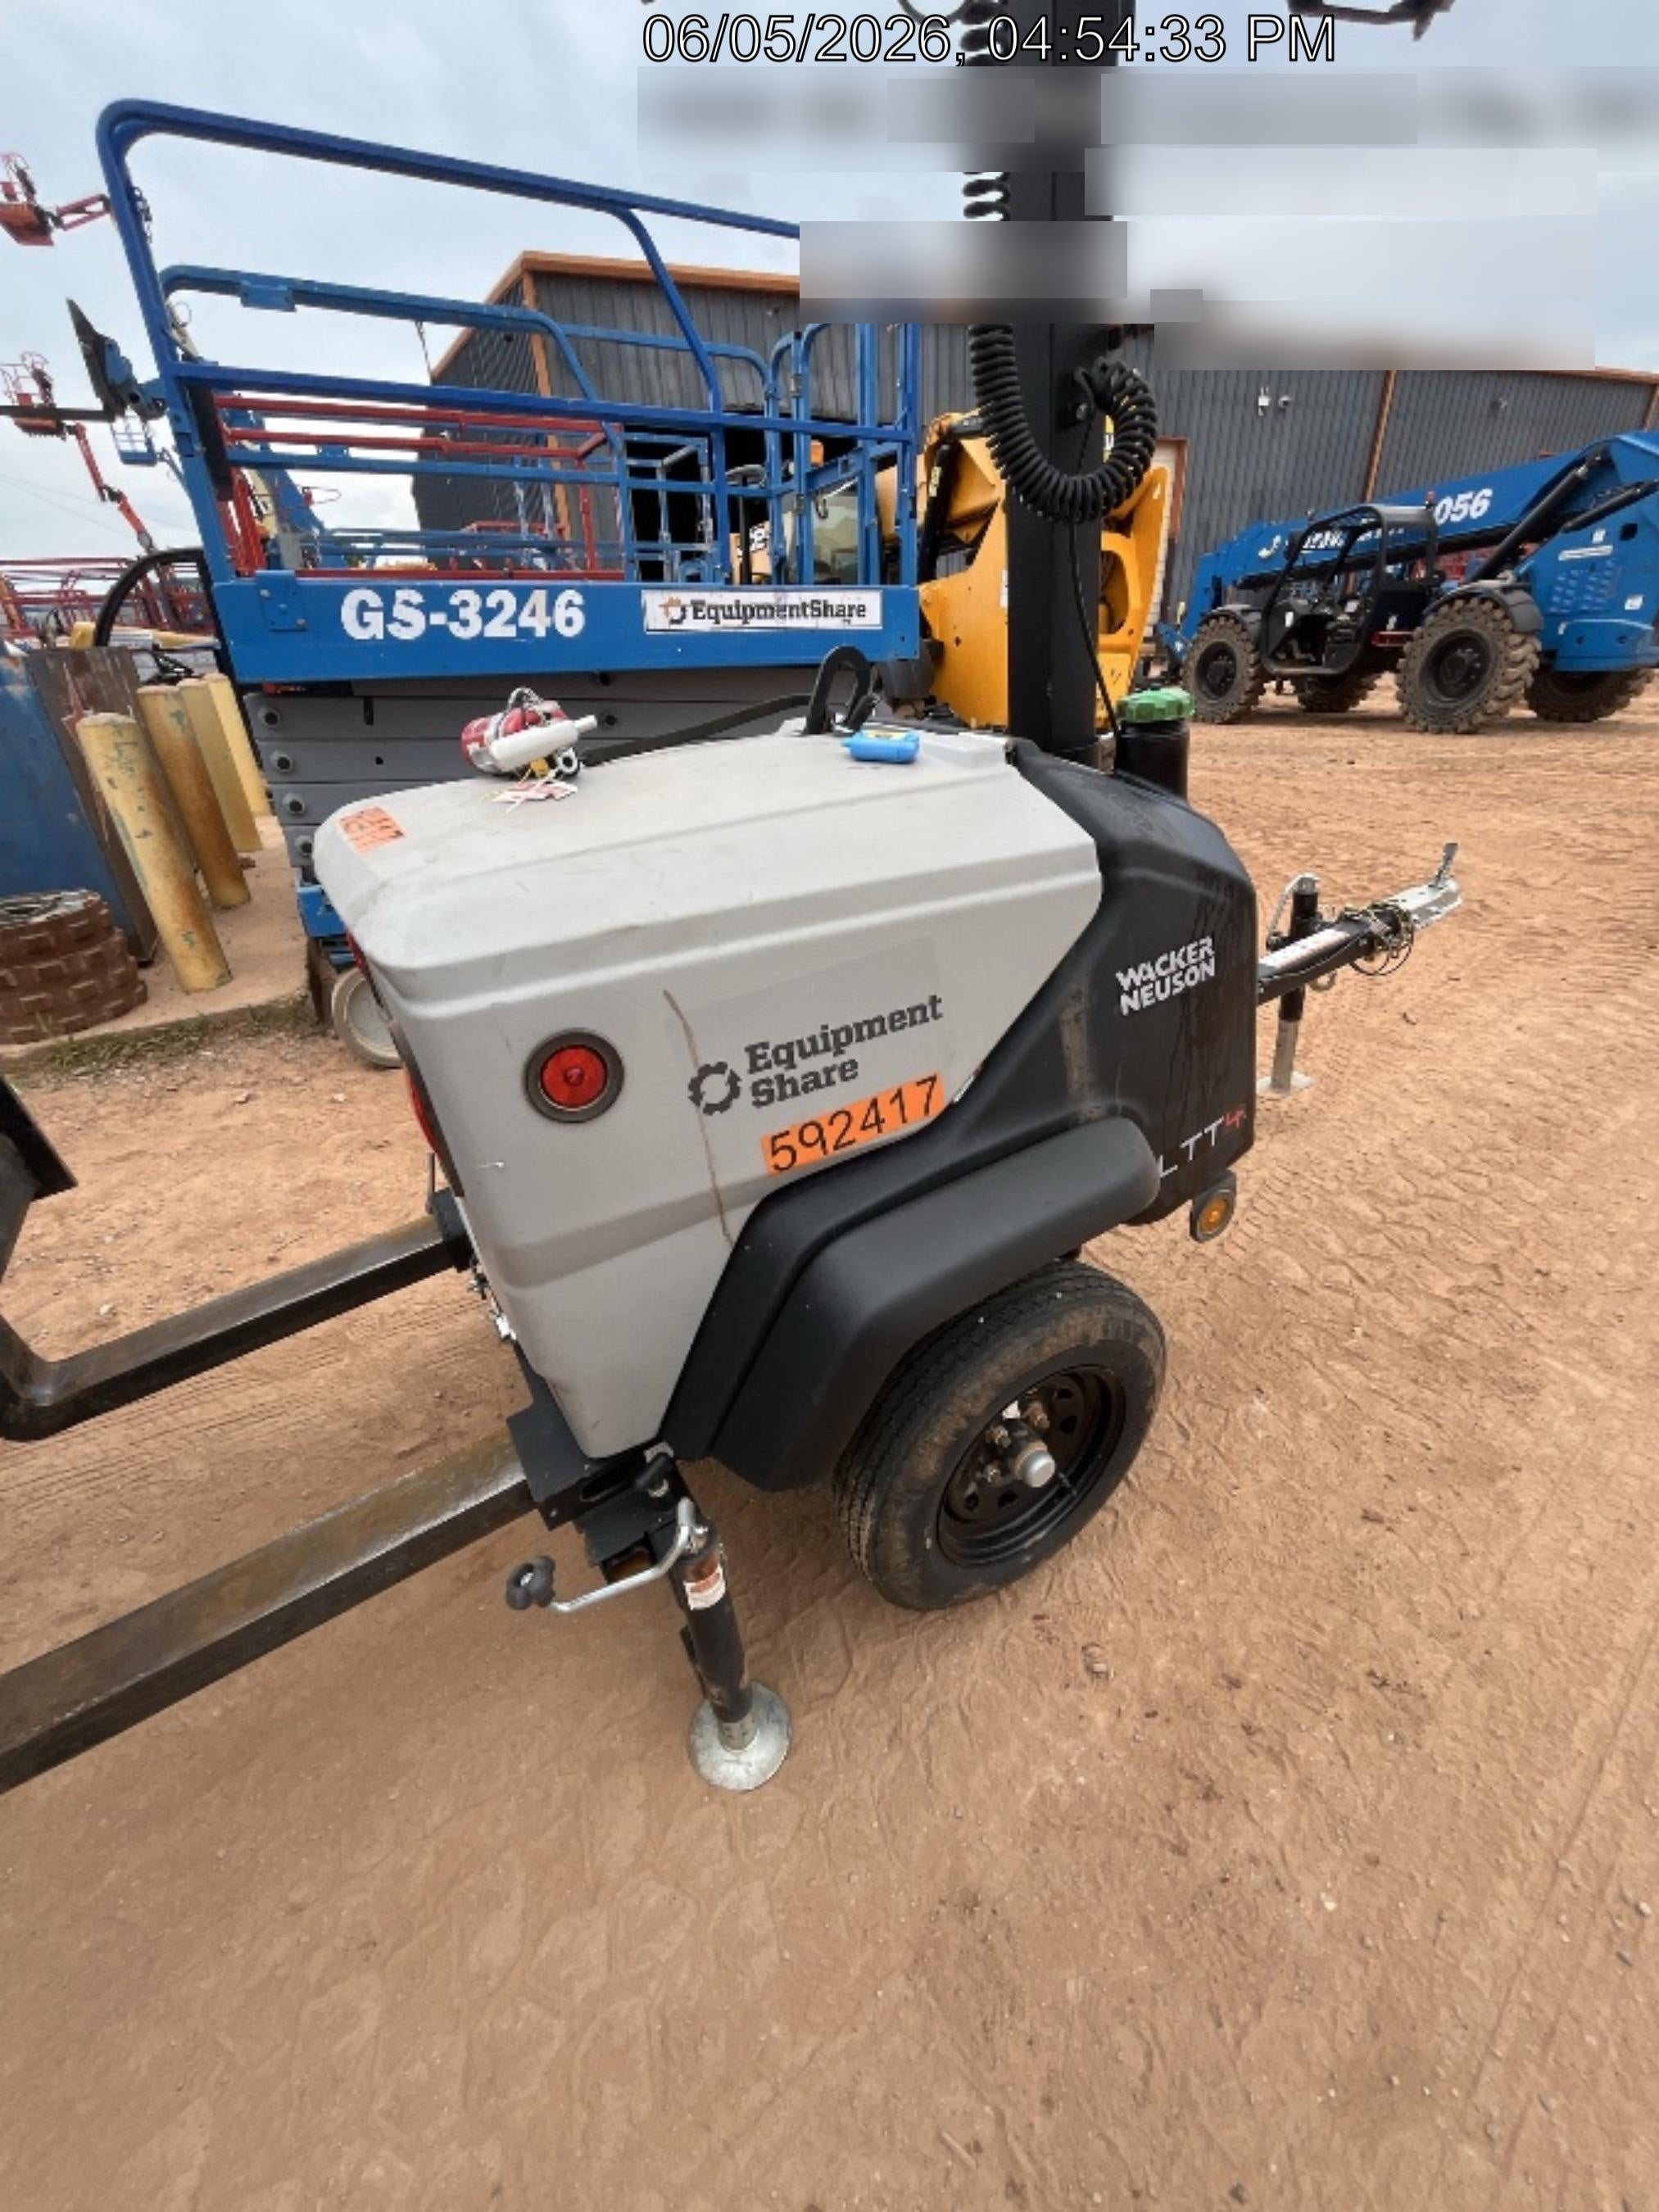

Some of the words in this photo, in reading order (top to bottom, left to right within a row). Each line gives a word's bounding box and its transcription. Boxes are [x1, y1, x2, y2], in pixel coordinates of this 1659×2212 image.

[341, 588, 586, 641] GS-3246
[690, 599, 867, 624] EquipmentShare
[1115, 936, 1214, 990] WACKER
[1120, 956, 1215, 1016] NEUSON
[744, 994, 944, 1074] Equipment
[750, 1058, 859, 1108] Share
[769, 1073, 938, 1172] 592417
